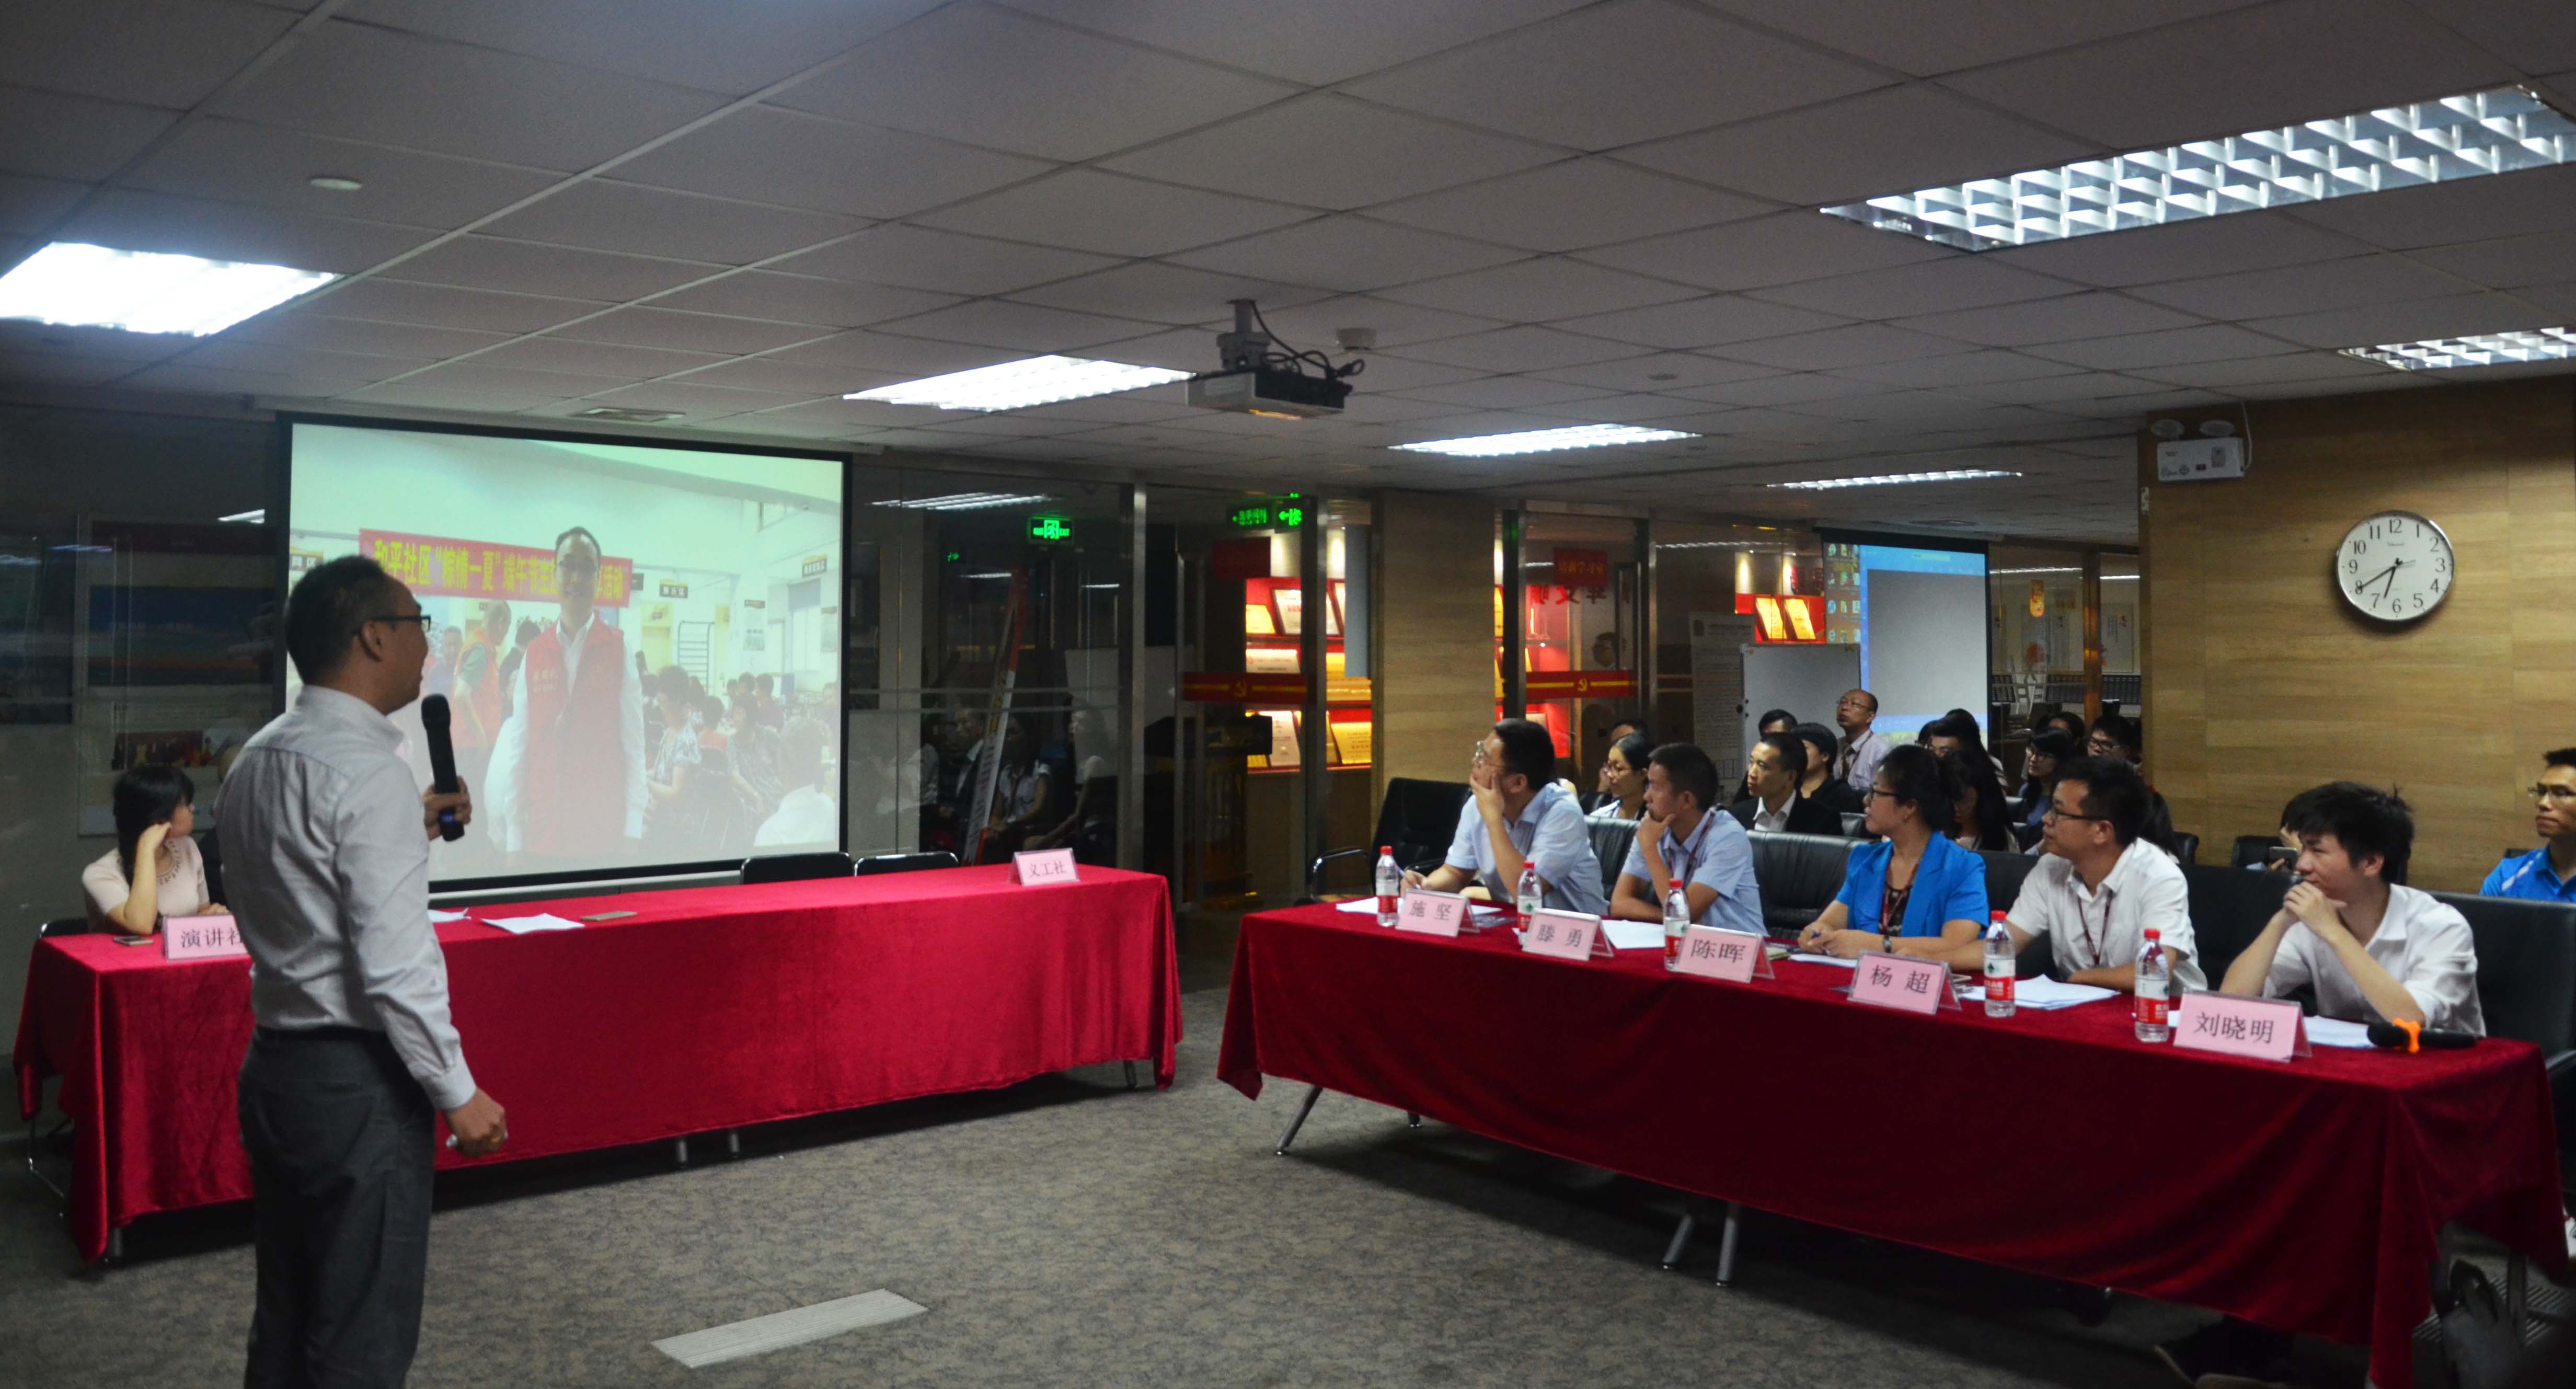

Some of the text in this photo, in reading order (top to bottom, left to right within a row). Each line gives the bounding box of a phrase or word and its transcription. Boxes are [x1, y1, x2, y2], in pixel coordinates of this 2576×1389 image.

[2370, 524, 2380, 539] 11
[2389, 518, 2402, 534] 12
[2416, 523, 2420, 538] 1
[2353, 539, 2366, 555] 10
[2429, 536, 2439, 552] 2
[2349, 559, 2358, 574] 9
[2435, 557, 2445, 572] 3
[2355, 580, 2363, 595] 8
[2430, 578, 2440, 593] 4
[2372, 593, 2380, 609] 7
[2392, 598, 2401, 613] 6
[2413, 593, 2423, 608] 5
[1029, 859, 1067, 878] 义工社
[1690, 938, 1747, 963] 陈晖
[1870, 965, 1930, 994] 杨超
[2193, 1012, 2274, 1043] 刘晓明
